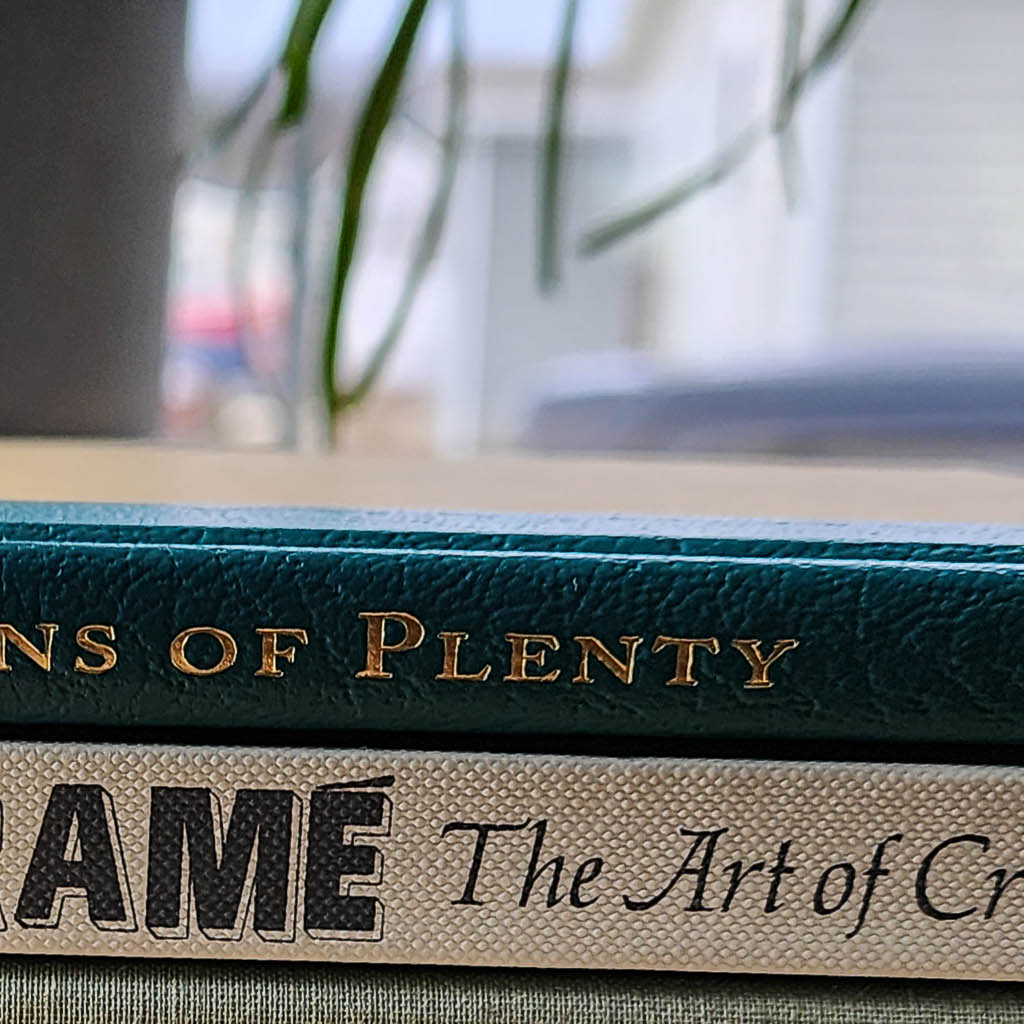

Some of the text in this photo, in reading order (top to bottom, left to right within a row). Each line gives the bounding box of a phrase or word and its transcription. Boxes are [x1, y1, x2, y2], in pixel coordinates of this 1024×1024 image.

[169, 625, 309, 678] OF
[354, 611, 800, 690] PLENTY
[440, 816, 606, 909] The
[621, 826, 795, 915] Art
[813, 832, 904, 939] of
